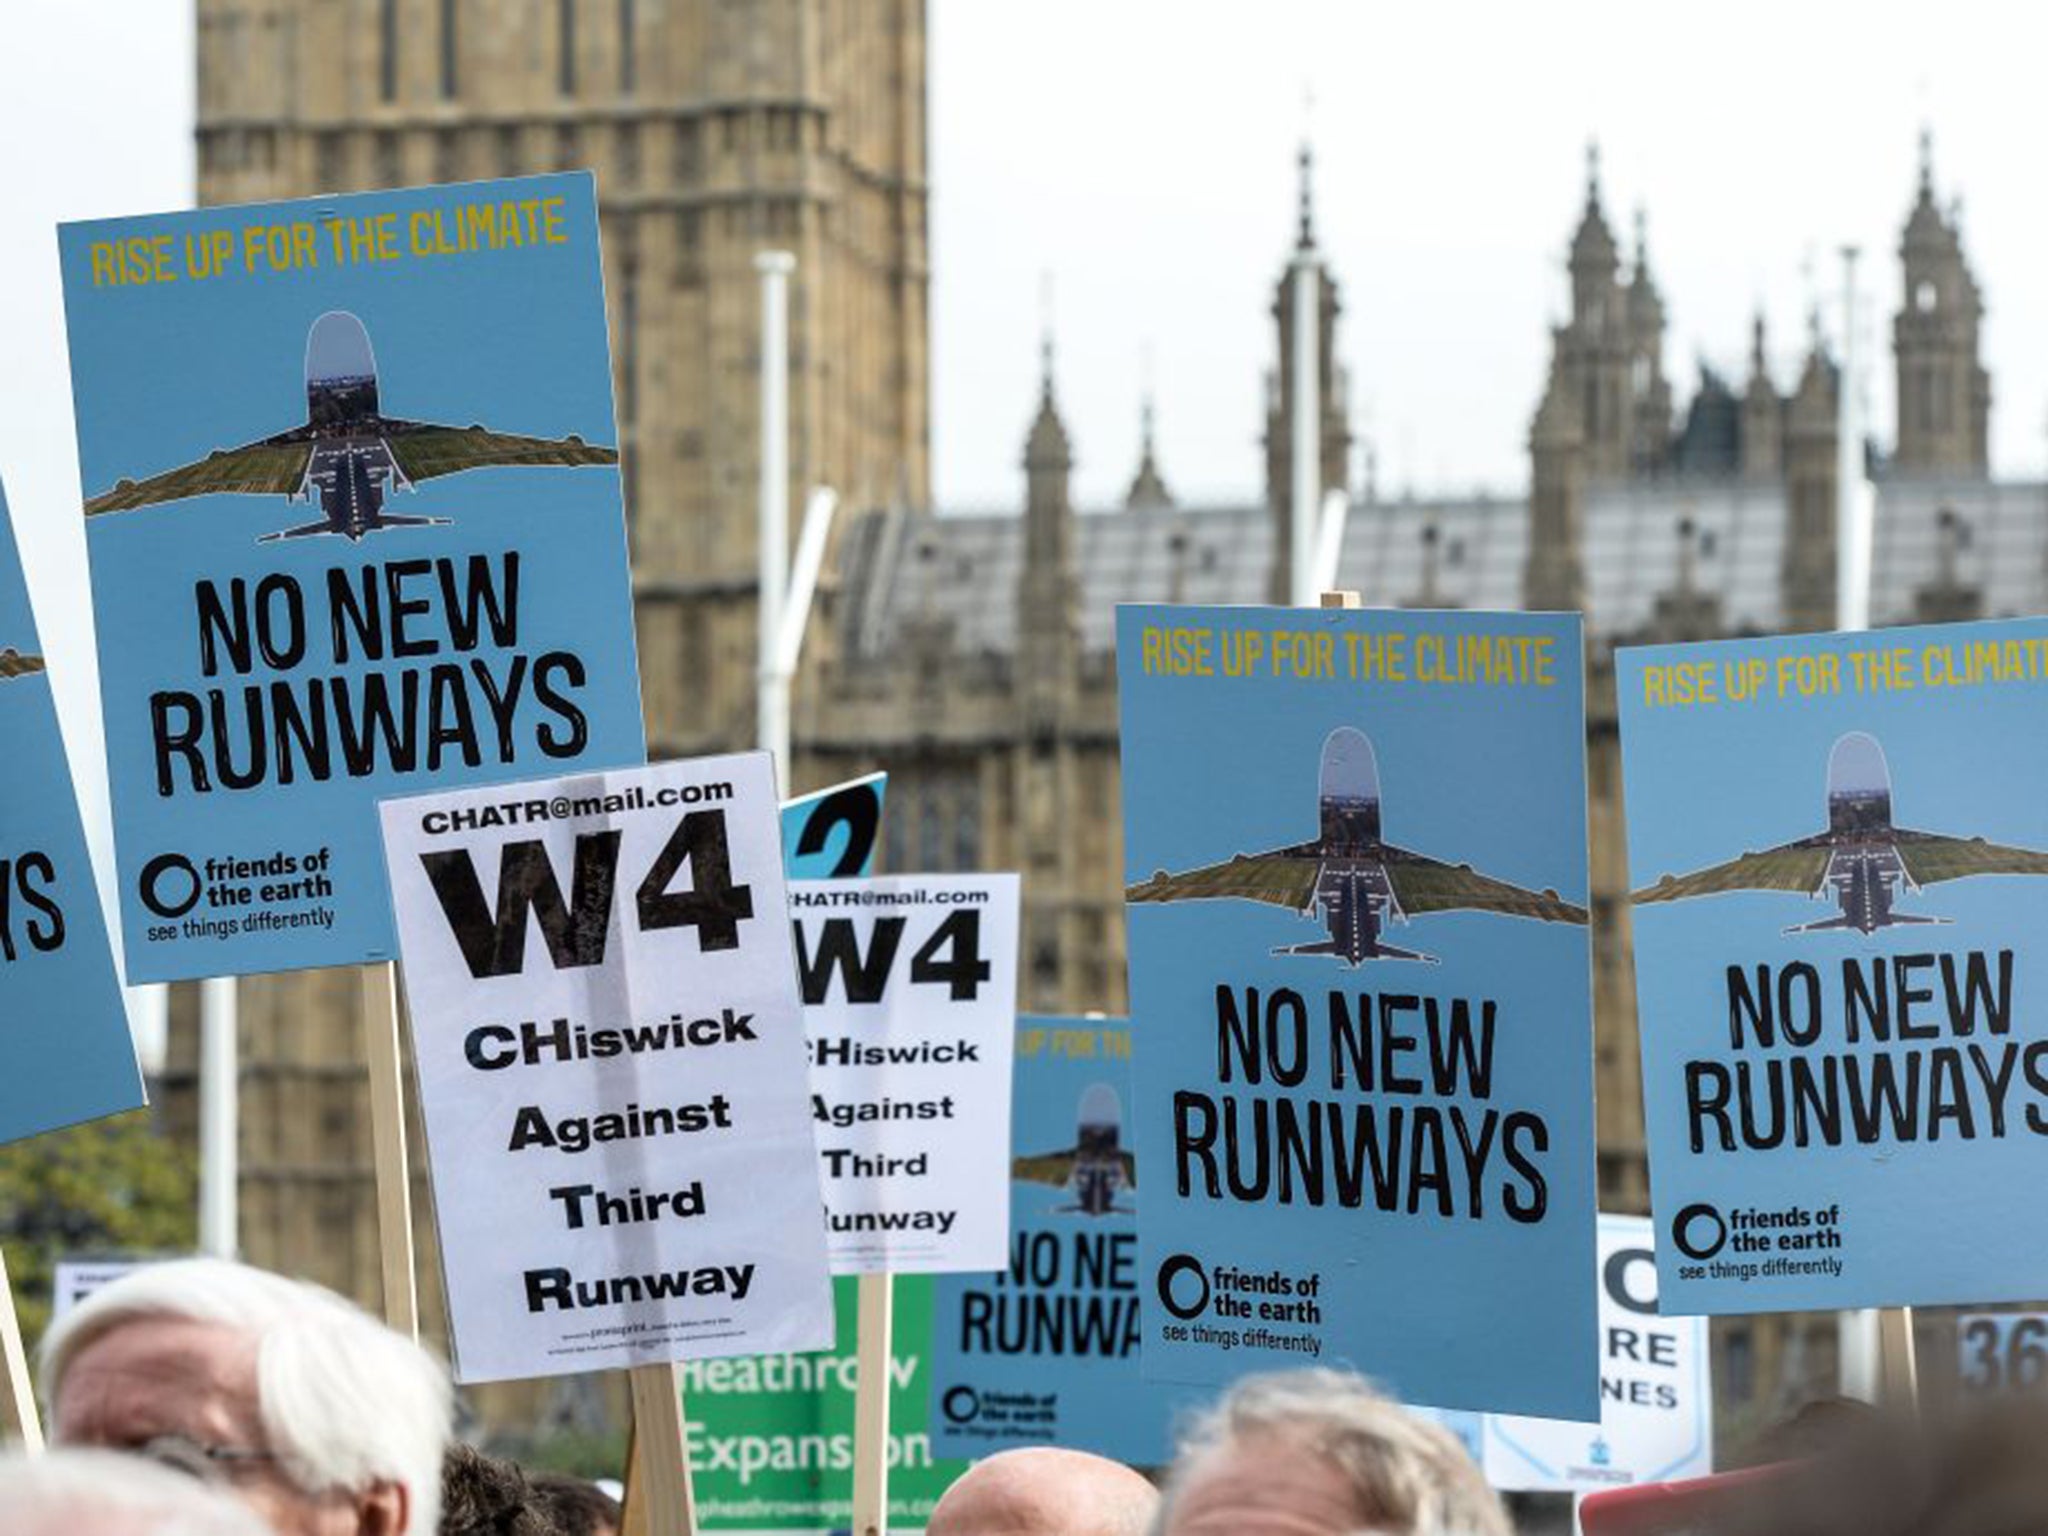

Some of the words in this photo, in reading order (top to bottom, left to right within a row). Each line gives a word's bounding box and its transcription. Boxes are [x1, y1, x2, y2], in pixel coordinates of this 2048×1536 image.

[90, 235, 178, 285] RISE
[185, 230, 234, 280] UP
[243, 222, 317, 273] FOR
[323, 212, 401, 266] THE
[409, 195, 568, 258] CLIMATE
[196, 573, 302, 677] NO
[327, 551, 520, 665] NEW
[1142, 626, 1214, 676] RISE
[1221, 629, 1264, 676] UP
[1270, 630, 1335, 677] FOR
[1343, 630, 1407, 682] THE
[1414, 632, 1556, 687] CLIMATE
[1644, 661, 1718, 707] RISE
[1724, 657, 1768, 702] UP
[1775, 652, 1841, 699] FOR
[1847, 648, 1915, 694] THE
[1921, 639, 2048, 686] CLIMAT
[149, 652, 588, 796] RUNWAYS
[422, 782, 733, 835] CHATR@mail.com
[205, 852, 298, 881] friends
[303, 847, 329, 873] of
[207, 883, 252, 907] the
[260, 875, 332, 903] earth
[420, 809, 754, 978] W4
[787, 888, 989, 907] HATR@mail.com
[148, 924, 177, 941] see
[183, 917, 239, 941] things
[242, 906, 335, 931] differently
[793, 909, 991, 1005] W4
[1727, 960, 1821, 1050] NO
[1843, 949, 2014, 1041] NEW
[464, 1008, 757, 1071] CHiswick
[806, 1037, 979, 1066] Hiswick
[1216, 984, 1308, 1087] NO
[1327, 991, 1497, 1099] NEW
[508, 1094, 732, 1153] Against
[821, 1148, 927, 1179] Third
[1174, 1090, 1549, 1224] RUNWAYS
[549, 1181, 706, 1230] Third
[824, 1206, 957, 1235] unway
[1730, 1206, 1810, 1230] friends
[1816, 1204, 1839, 1225] of
[1730, 1232, 1771, 1252] the
[1778, 1228, 1842, 1251] earth
[523, 1263, 755, 1313] Runway
[1213, 1266, 1292, 1296] friends
[1297, 1273, 1320, 1297] of
[1678, 1265, 1706, 1280] see
[1709, 1260, 1758, 1282] things
[1762, 1256, 1843, 1277] differently
[1214, 1294, 1253, 1318] the
[1259, 1300, 1321, 1324] earth
[1162, 1325, 1188, 1341] see
[1191, 1324, 1240, 1350] things
[1242, 1327, 1322, 1357] differently
